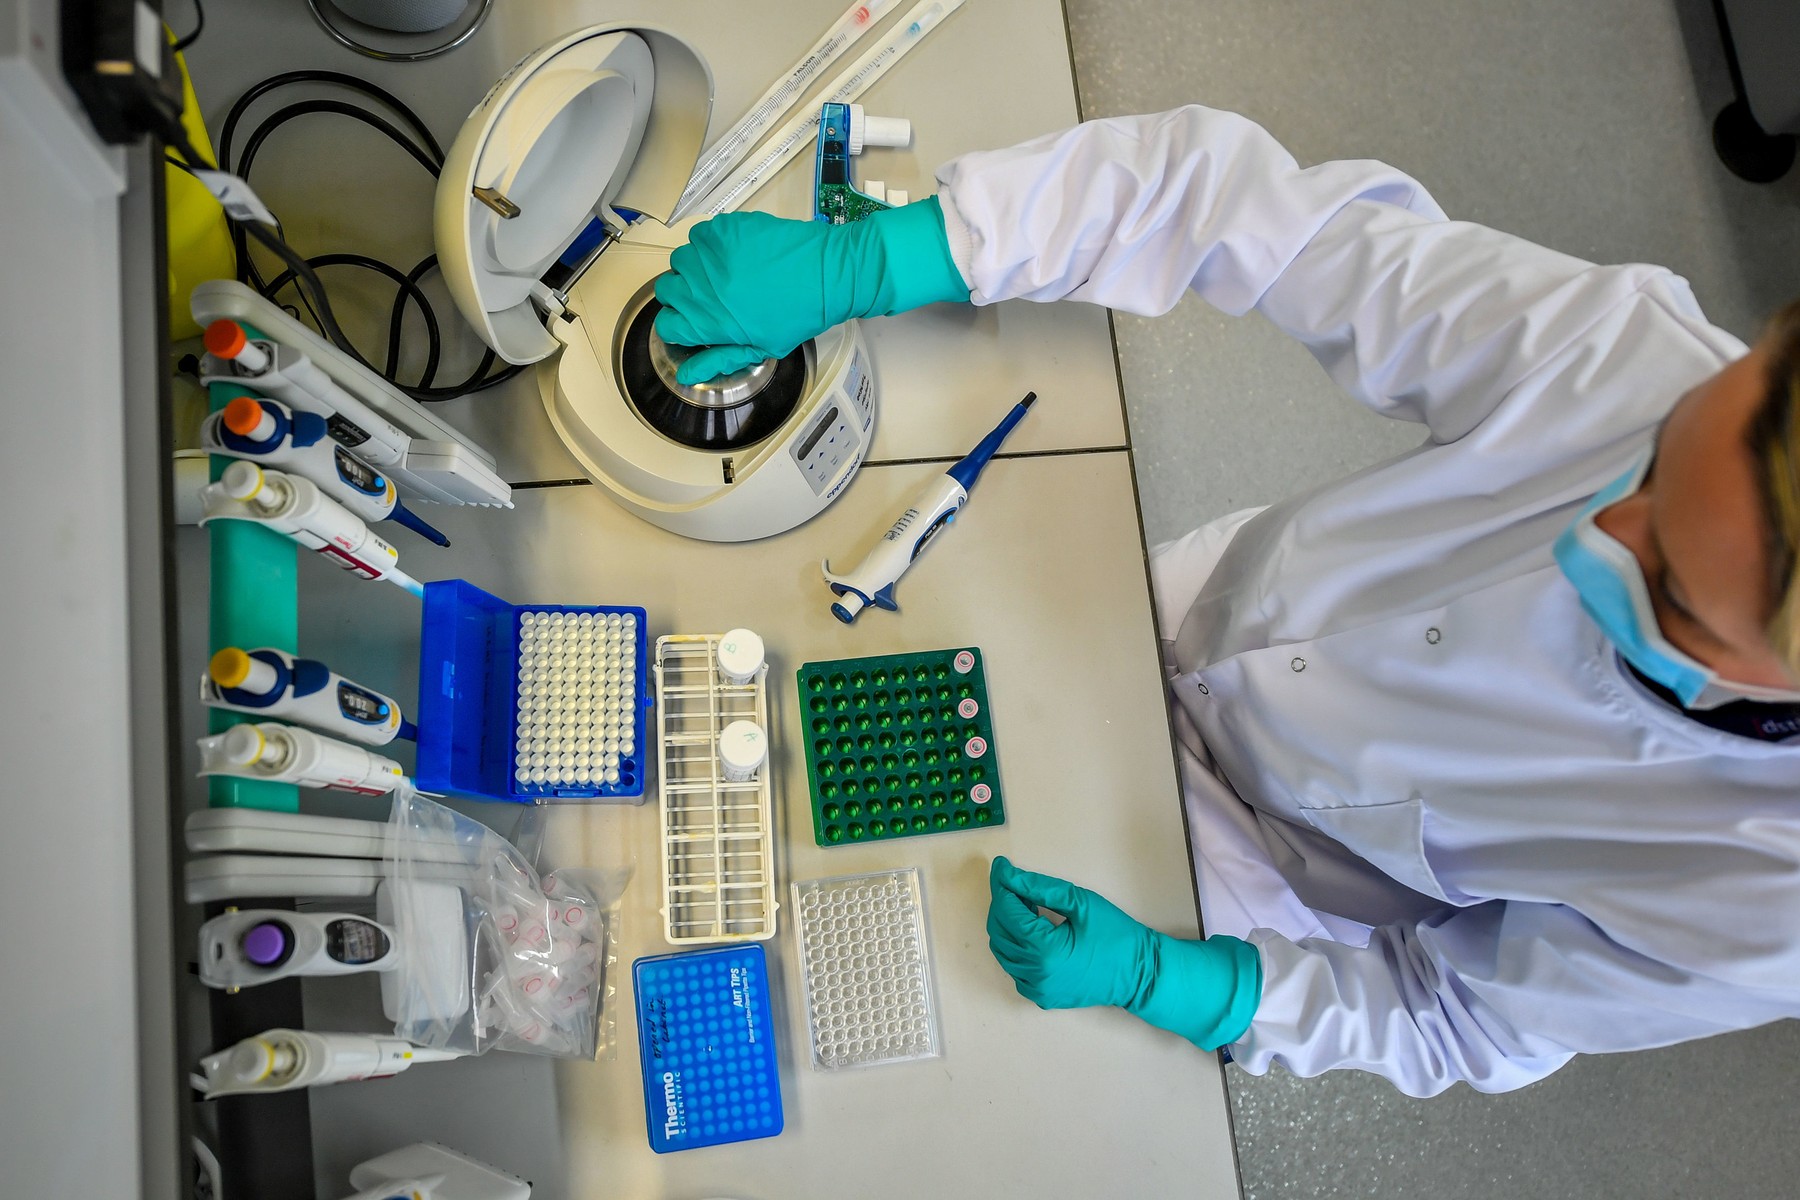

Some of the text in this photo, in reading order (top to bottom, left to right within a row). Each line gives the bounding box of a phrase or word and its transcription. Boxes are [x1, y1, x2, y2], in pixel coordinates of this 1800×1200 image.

[793, 56, 816, 77] FALCON
[827, 452, 861, 499] eppendorf
[733, 989, 743, 1008] ART
[646, 1018, 663, 1059] opened
[663, 1071, 676, 1141] Thermo
[674, 1071, 687, 1134] SCIENTIFIC
